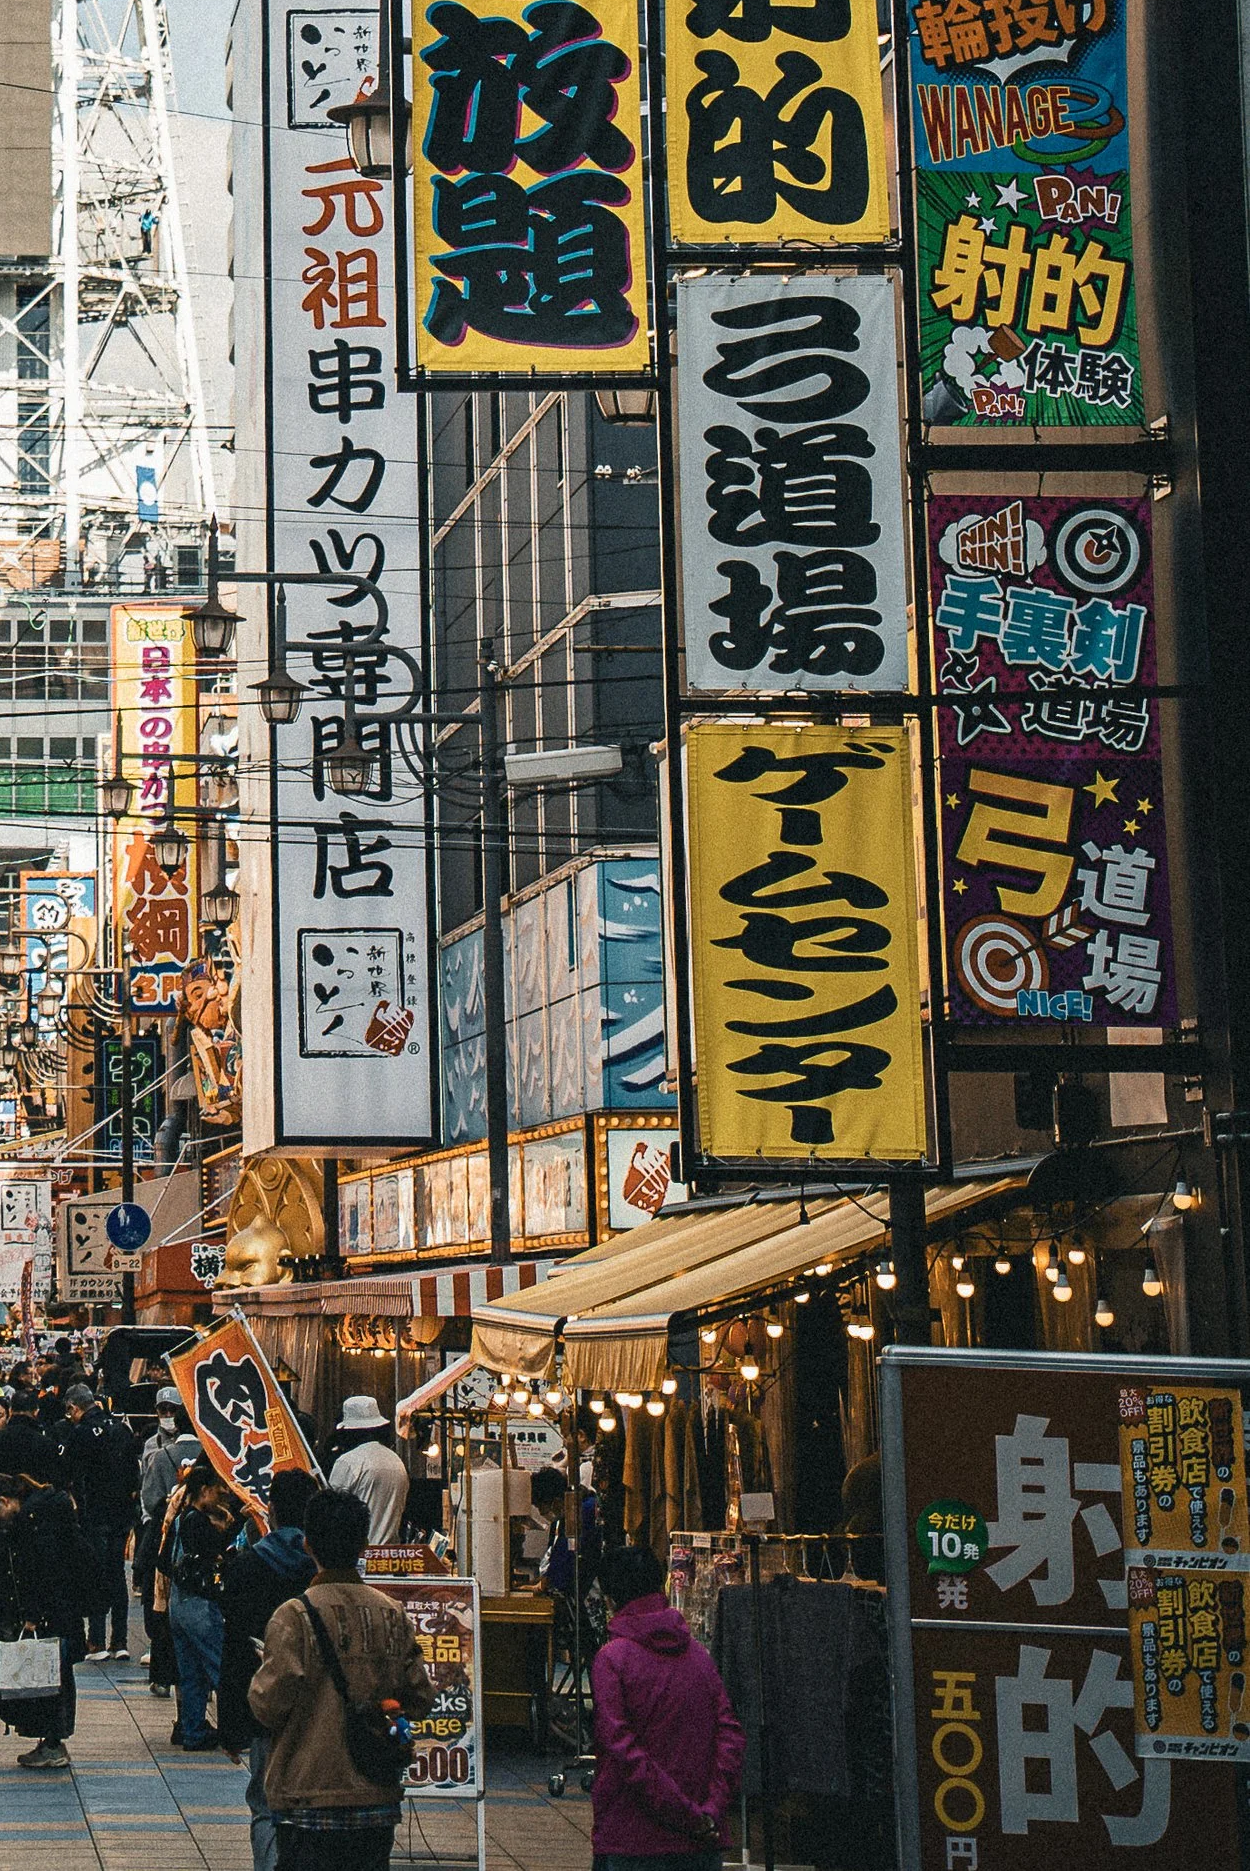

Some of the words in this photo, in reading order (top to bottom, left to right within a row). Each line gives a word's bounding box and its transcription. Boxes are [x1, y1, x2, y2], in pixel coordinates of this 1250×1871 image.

[917, 83, 1074, 165] WANAGE
[1033, 174, 1122, 226] PAN!
[931, 215, 1126, 345] 射的
[971, 386, 1026, 419] PAN!
[1021, 339, 1133, 407] 体験
[127, 619, 186, 642] 新世界
[936, 575, 1147, 684] 手裏剣
[1022, 672, 1151, 752] 道場
[957, 769, 1075, 916] 弓
[1077, 840, 1162, 1013] 道場
[707, 740, 898, 1145] ゲームセンター
[1016, 990, 1093, 1022] NICE!
[1120, 1407, 1144, 1418] OFF!
[1132, 1439, 1148, 1542] 景品もあります
[1147, 1406, 1177, 1507] 割引券の
[1178, 1398, 1208, 1543] 飲食店で使える
[927, 1531, 980, 1560] 10発
[928, 1512, 977, 1531] 今だけ
[366, 1559, 425, 1572] おまけ付き
[1142, 1622, 1158, 1728] 景品もあります
[1157, 1588, 1187, 1693] 割引券の
[1188, 1581, 1218, 1729] 飲食店で使える
